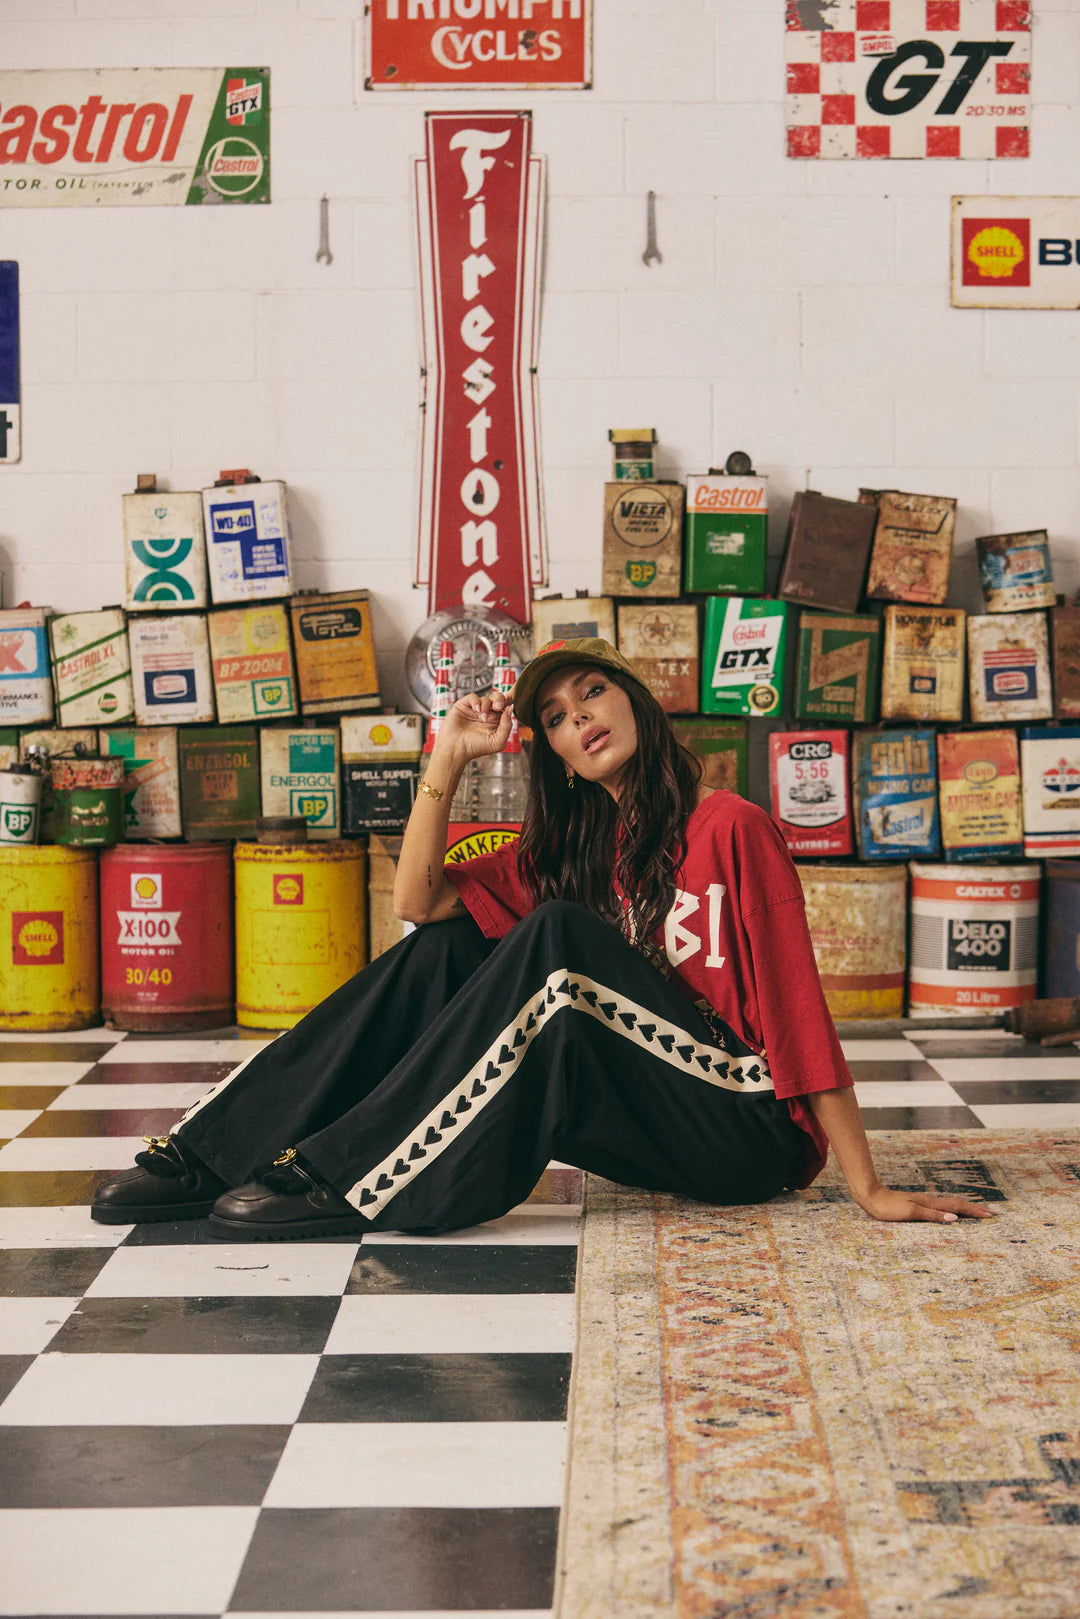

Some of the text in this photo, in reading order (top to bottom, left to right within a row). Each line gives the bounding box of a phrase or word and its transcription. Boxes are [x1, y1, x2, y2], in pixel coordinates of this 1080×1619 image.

[431, 26, 562, 70] CYCLES
[865, 40, 1015, 115] GT
[229, 96, 258, 116] GTX
[0, 94, 194, 164] astrol
[213, 158, 260, 173] Castrol
[55, 178, 87, 190] OIL
[977, 245, 1017, 257] SHELL
[448, 128, 512, 608] Firestone
[694, 485, 764, 507] Castrol
[620, 501, 667, 518] VICTA
[216, 514, 251, 530] WD-40
[631, 564, 655, 582] BP
[59, 650, 102, 680] CASTROL
[103, 643, 116, 659] XL
[720, 646, 773, 669] GTX
[219, 661, 239, 678] BP
[241, 656, 284, 676] ZOOM
[264, 689, 281, 701] BP
[790, 742, 831, 758] CRC
[186, 752, 251, 771] ENERGOL
[270, 775, 336, 787] ENERGOL
[867, 778, 936, 795] MIXING CAN
[302, 800, 326, 816] BP
[8, 813, 30, 831] BP
[956, 886, 1005, 897] CALTEX
[24, 934, 53, 943] SHELL
[952, 921, 1006, 940] DELO
[121, 948, 175, 956] MOTOR OIL
[955, 940, 1002, 957] 400
[125, 967, 172, 985] 30/40
[956, 991, 1000, 1003] 20 Litre
